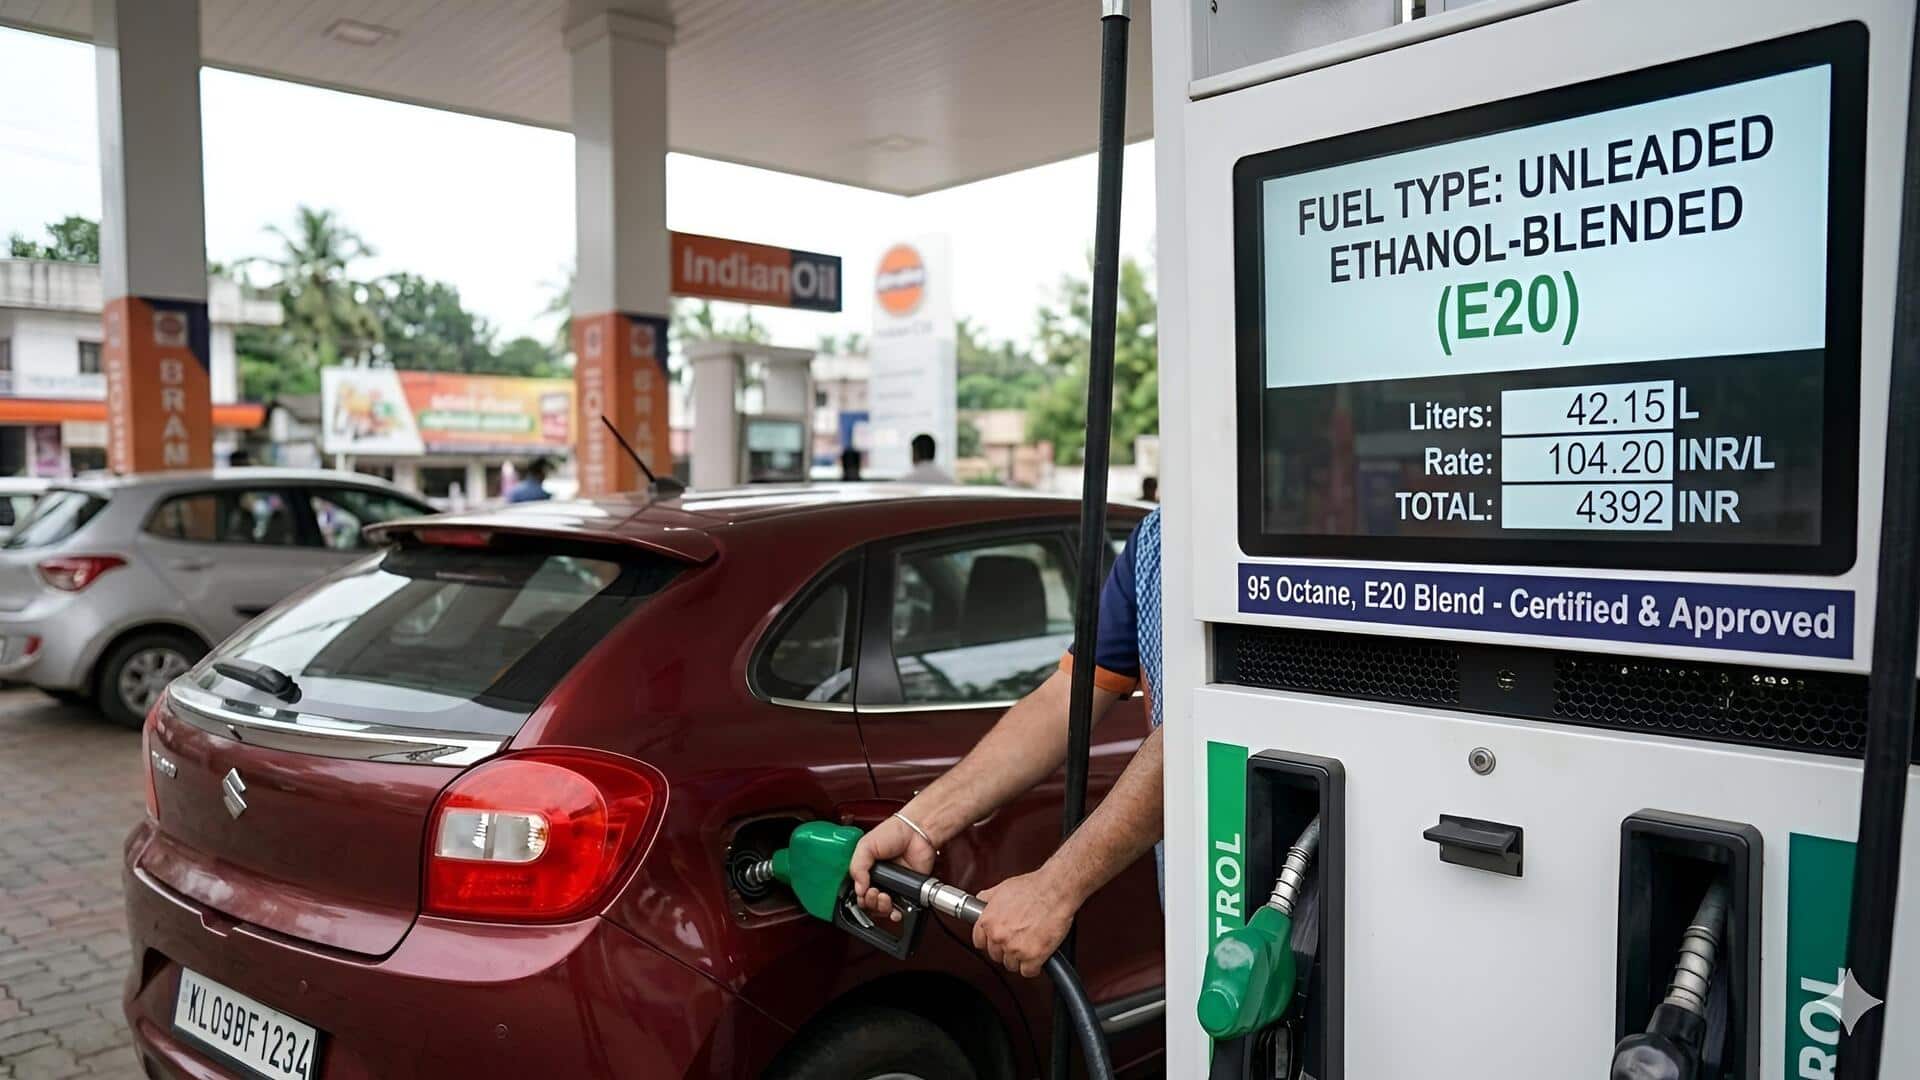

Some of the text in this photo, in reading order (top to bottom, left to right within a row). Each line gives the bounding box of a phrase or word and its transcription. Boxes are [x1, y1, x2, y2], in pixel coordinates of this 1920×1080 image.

[1299, 114, 1774, 236] FUEL TYPE: UNLEADED
[1330, 184, 1743, 283] ETHANOL-BLENDED
[1437, 270, 1579, 356] (E20)
[1409, 386, 1700, 431] Liters: 42.15 L
[1425, 436, 1776, 476] Rate: 104.20 INR/L
[1395, 490, 1741, 524] TOTAL: 4392 INR
[1247, 575, 1271, 601] 95
[1276, 576, 1356, 611] Octane,
[1364, 580, 1406, 610] E20
[1414, 583, 1484, 615] Blend
[1510, 588, 1629, 625] Certified
[1638, 594, 1661, 627] &
[1668, 596, 1836, 640] Approved
[1215, 832, 1241, 938] TROL
[188, 983, 310, 1080] KL09BF1234
[1798, 967, 1846, 1080] ROL
